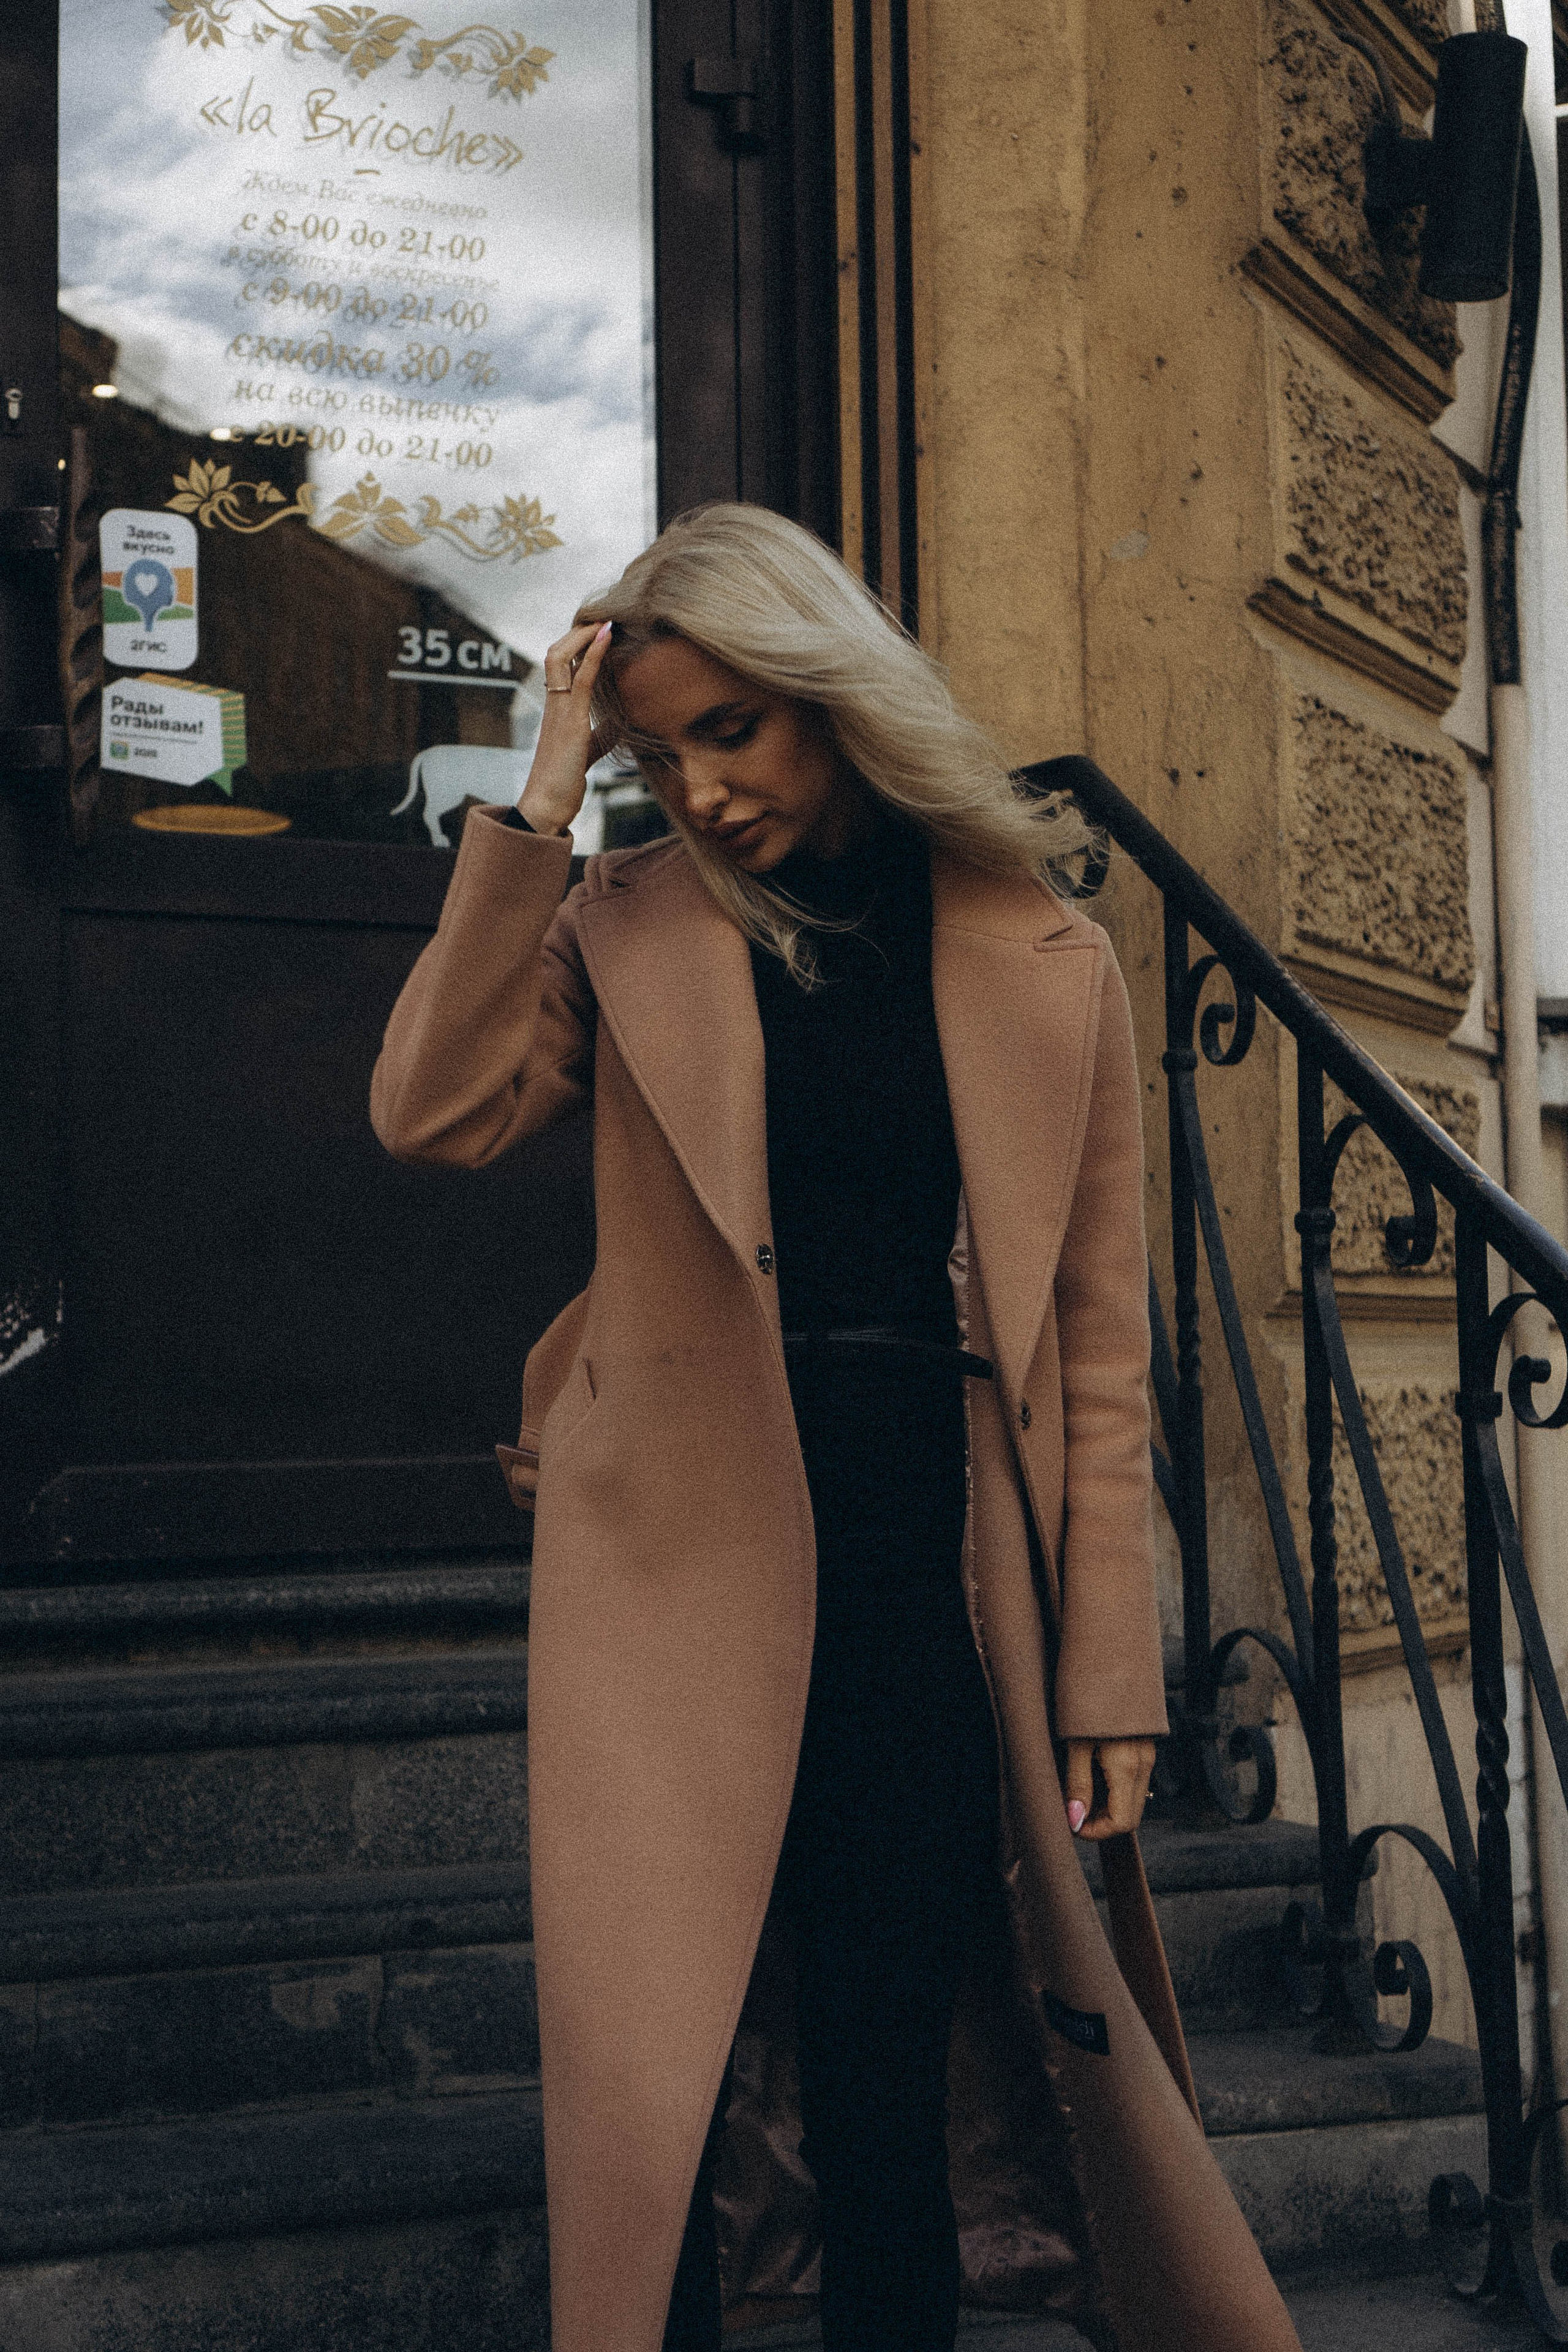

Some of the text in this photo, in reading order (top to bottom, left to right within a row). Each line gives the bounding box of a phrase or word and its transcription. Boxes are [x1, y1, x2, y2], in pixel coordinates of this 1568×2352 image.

[304, 88, 525, 171] Brioche»
[318, 179, 357, 203] Вас
[366, 192, 488, 219] ежедневно
[240, 209, 486, 262] с 8-00 до 21-00
[247, 246, 341, 276] субботу
[349, 261, 361, 273] и
[370, 263, 500, 291] воскресенье
[242, 277, 488, 330] с 9-00 до 21-00
[232, 330, 501, 388] скидка 30 %
[235, 380, 500, 432] на всю выпечку
[255, 421, 347, 452] 20-00
[358, 429, 393, 458] до
[405, 435, 494, 468] 21-00
[123, 542, 175, 555] вкусно
[127, 525, 171, 540] Здесь
[130, 639, 167, 654] 2ГИС
[397, 625, 451, 668] 35
[110, 715, 203, 734] отзывам!
[111, 696, 164, 715] Рады
